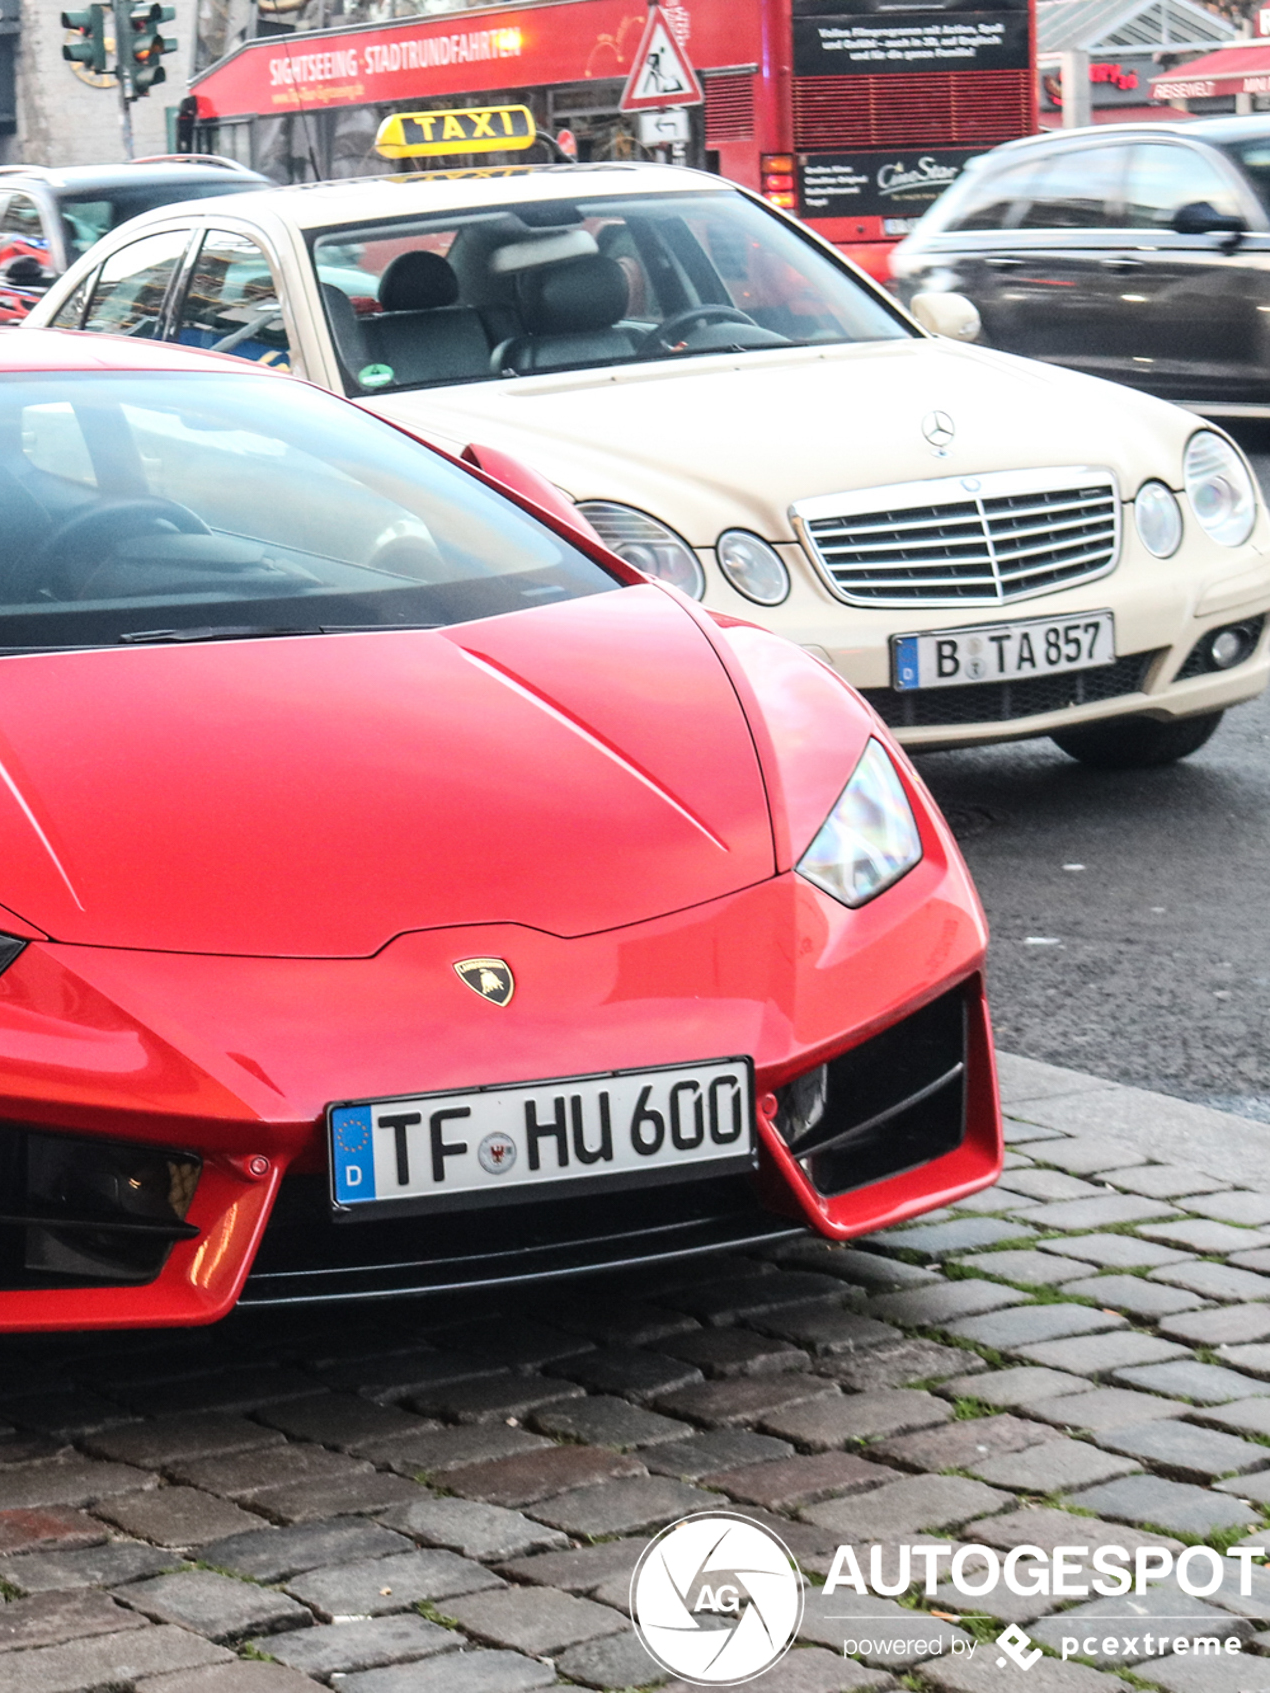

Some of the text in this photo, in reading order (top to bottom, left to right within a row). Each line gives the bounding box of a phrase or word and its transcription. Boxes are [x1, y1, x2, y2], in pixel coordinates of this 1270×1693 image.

[269, 27, 521, 85] SIGHTSEEING STADTRUNDFAHRTEN
[1153, 80, 1215, 99] REISEWELT
[413, 111, 514, 142] TAXI
[936, 621, 1101, 678] B TA 857
[903, 668, 913, 681] D
[377, 1074, 742, 1186] TF HU 600
[345, 1166, 363, 1187] D
